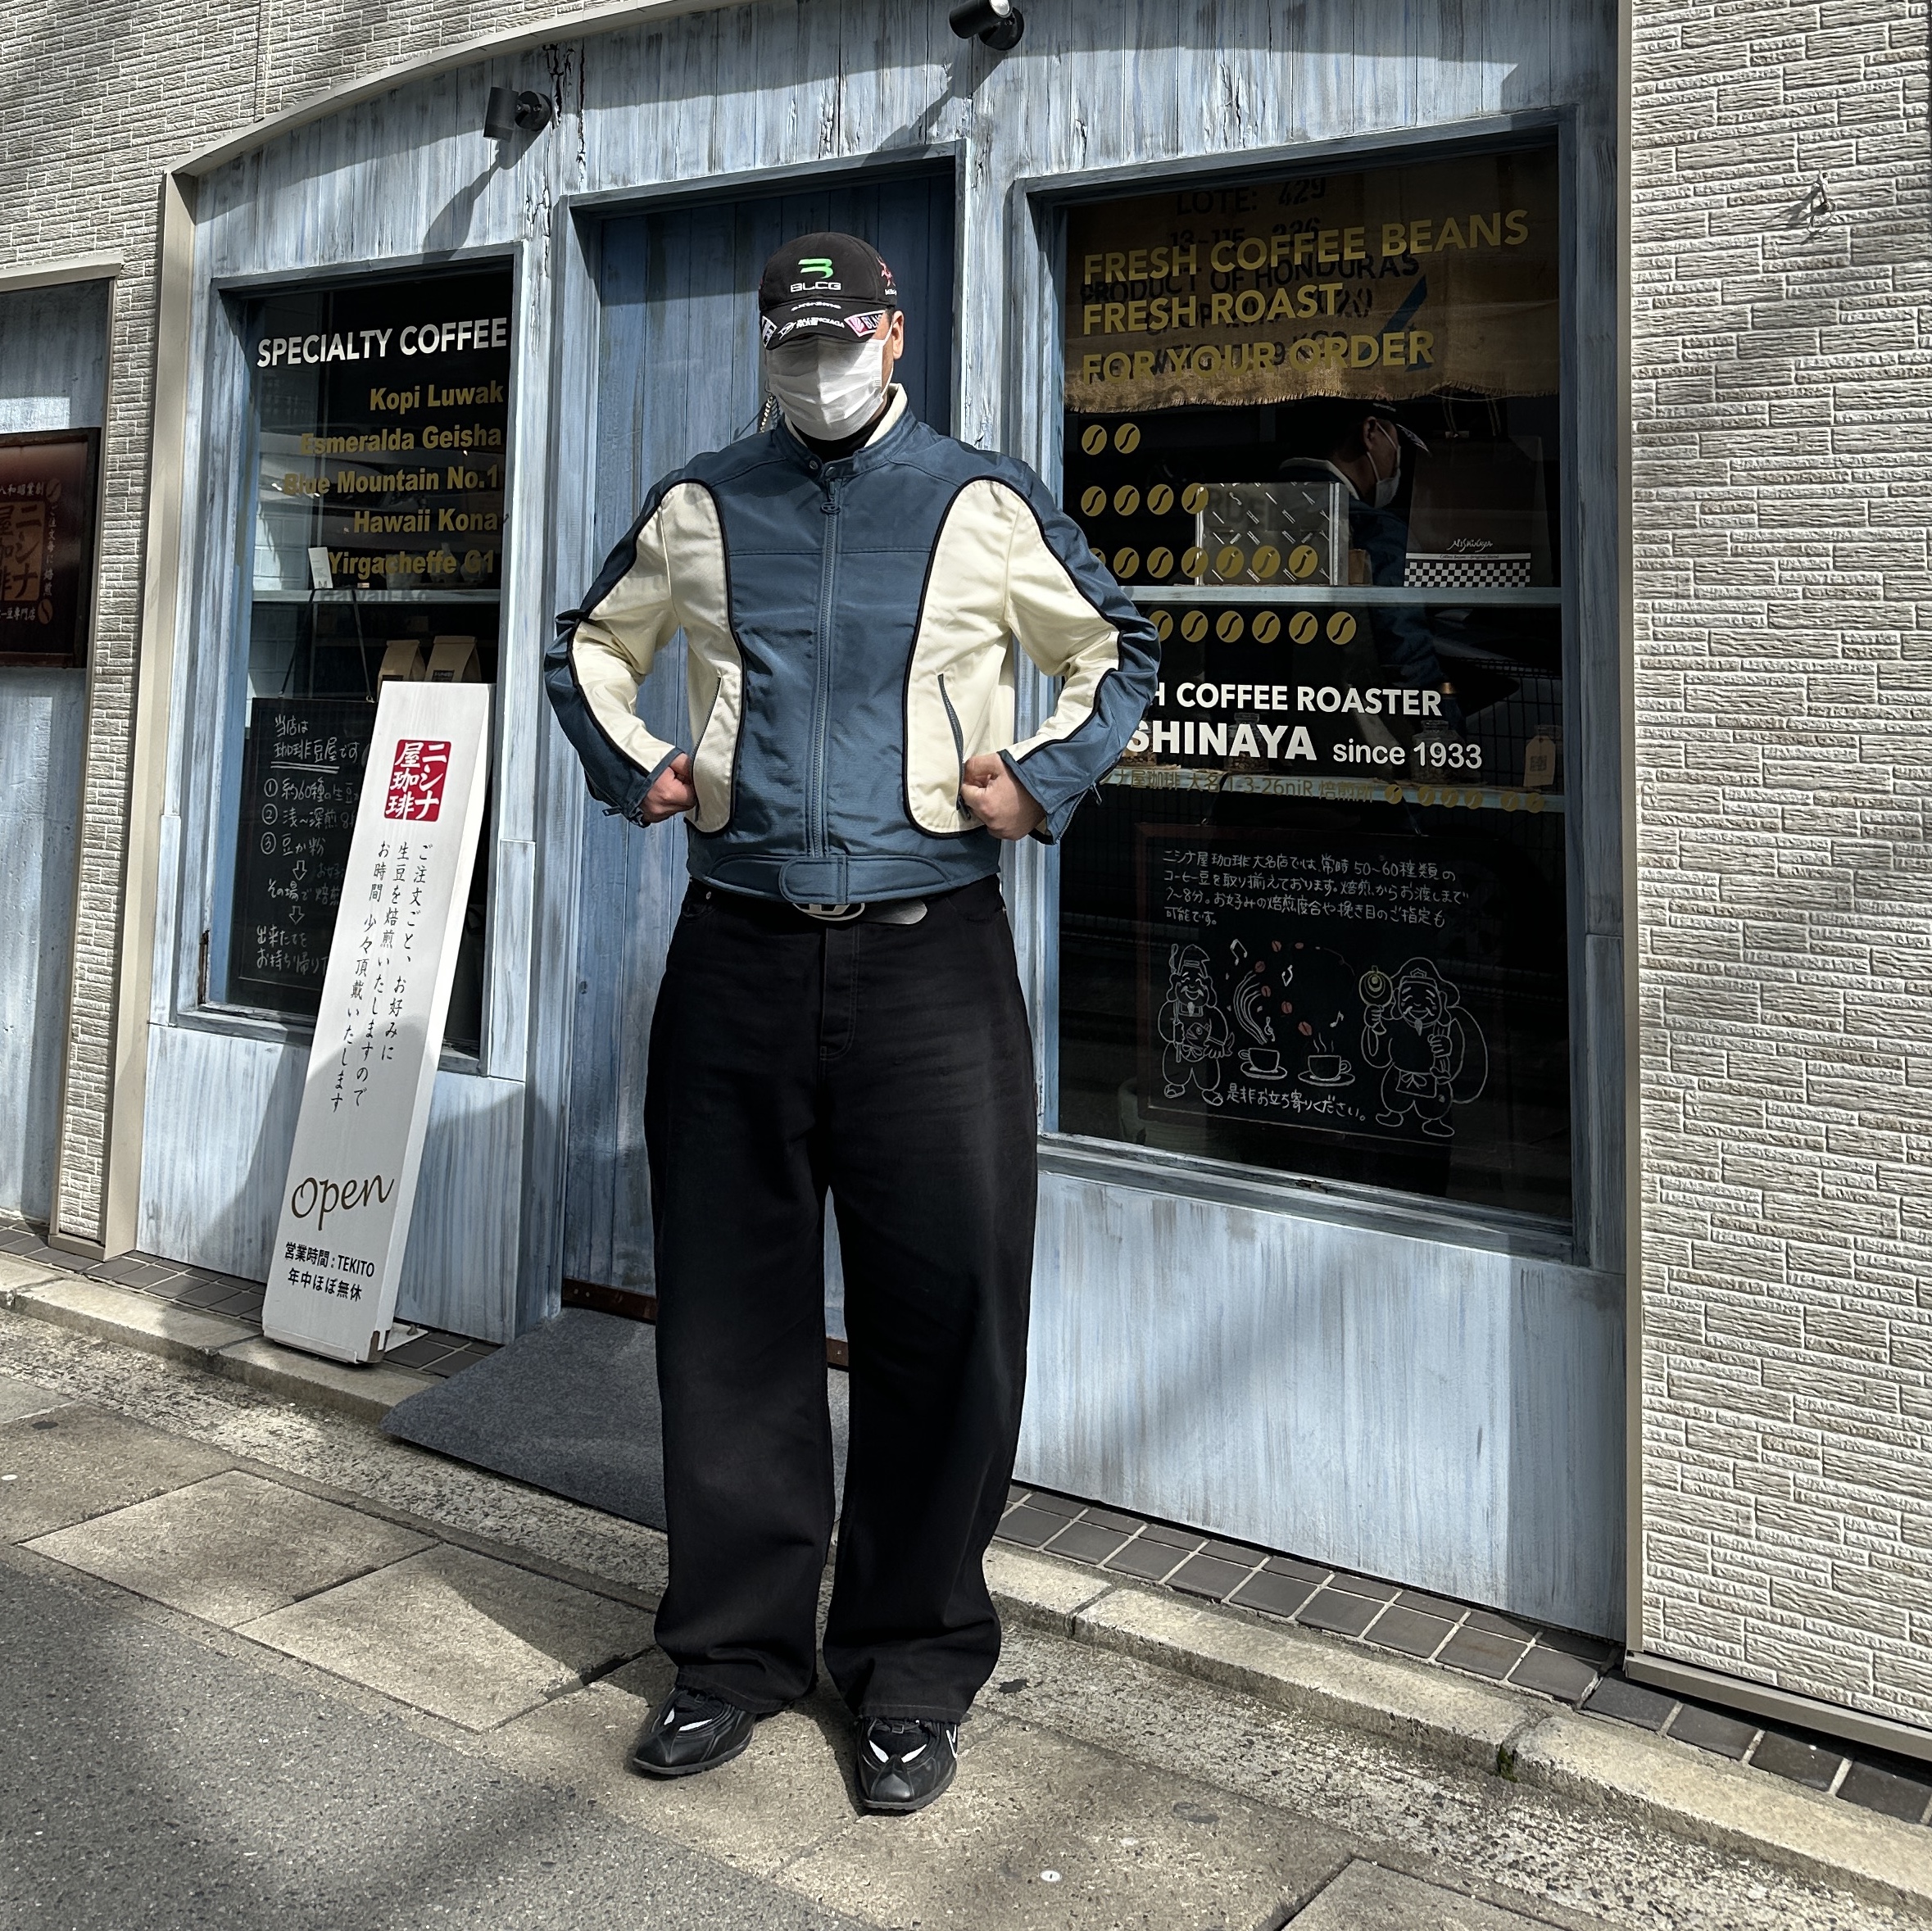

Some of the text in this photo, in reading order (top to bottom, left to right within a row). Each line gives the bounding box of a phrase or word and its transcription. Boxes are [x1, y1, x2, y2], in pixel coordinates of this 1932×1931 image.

[1177, 177, 1327, 216] LOTE: 429
[1084, 210, 1530, 285] FRESH COFFEE BEANS
[790, 281, 841, 292] BLCG
[1210, 266, 1245, 293] OF
[1083, 295, 1197, 335] FRESH
[1211, 282, 1344, 325] ROAST
[257, 317, 507, 368] SPECIALTY COFFEE
[1083, 350, 1155, 385] FOR
[1166, 341, 1276, 379] YOUR
[1289, 330, 1435, 372] ORDER
[370, 380, 504, 415] Kopi Luwak
[300, 423, 501, 456] Esmeralda Geisha
[283, 473, 330, 496] Blue
[337, 468, 439, 493] Mountain
[354, 508, 498, 533] Hawaii Kona
[12, 504, 42, 599] ニシナ
[329, 549, 457, 580] Yirgacheffe
[464, 549, 493, 573] G1
[1176, 682, 1288, 711] COFFEE
[1297, 687, 1442, 718] ROASTER
[274, 714, 309, 738] 当店は
[273, 736, 360, 764] 珈琲豆屋です
[1333, 737, 1406, 766] since
[1413, 741, 1482, 770] 1933
[385, 742, 424, 819] 屋珈琲
[413, 742, 448, 821] ニシナ
[1164, 906, 1218, 926] 可能です。
[256, 923, 307, 948] 出来たてを
[1226, 1082, 1367, 1122] 是非お立ち寄りください。
[291, 1174, 395, 1231] Open
[288, 1267, 362, 1303] 年中ほぼ無休
